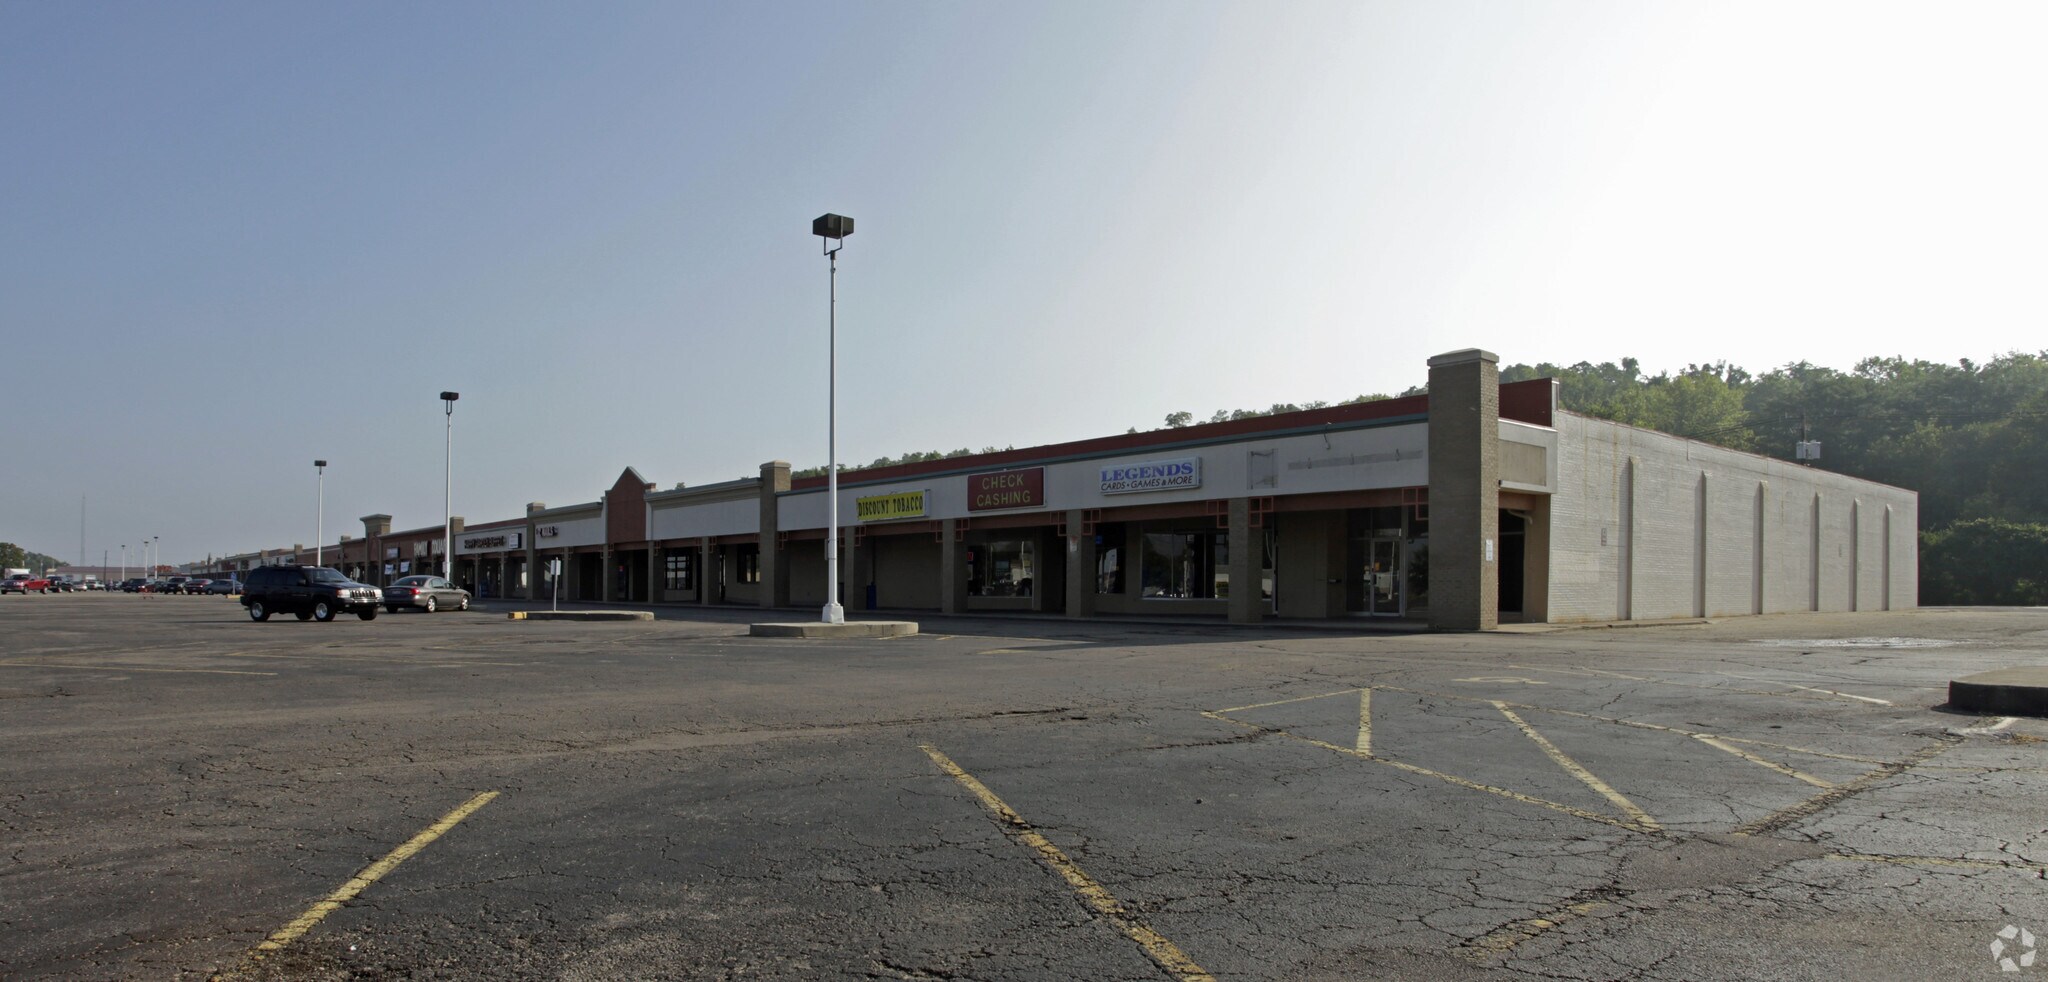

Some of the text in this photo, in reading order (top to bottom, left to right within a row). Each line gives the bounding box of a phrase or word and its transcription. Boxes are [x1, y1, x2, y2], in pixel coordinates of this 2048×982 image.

[1101, 462, 1194, 482] LEGENDS
[982, 474, 1024, 490] CHECK
[1100, 482, 1126, 491] CARDS
[1130, 478, 1160, 489] GAMES
[1167, 475, 1193, 485] MORE
[858, 496, 924, 517] DISCOUNT TOBACCO
[976, 490, 1031, 507] CASHING
